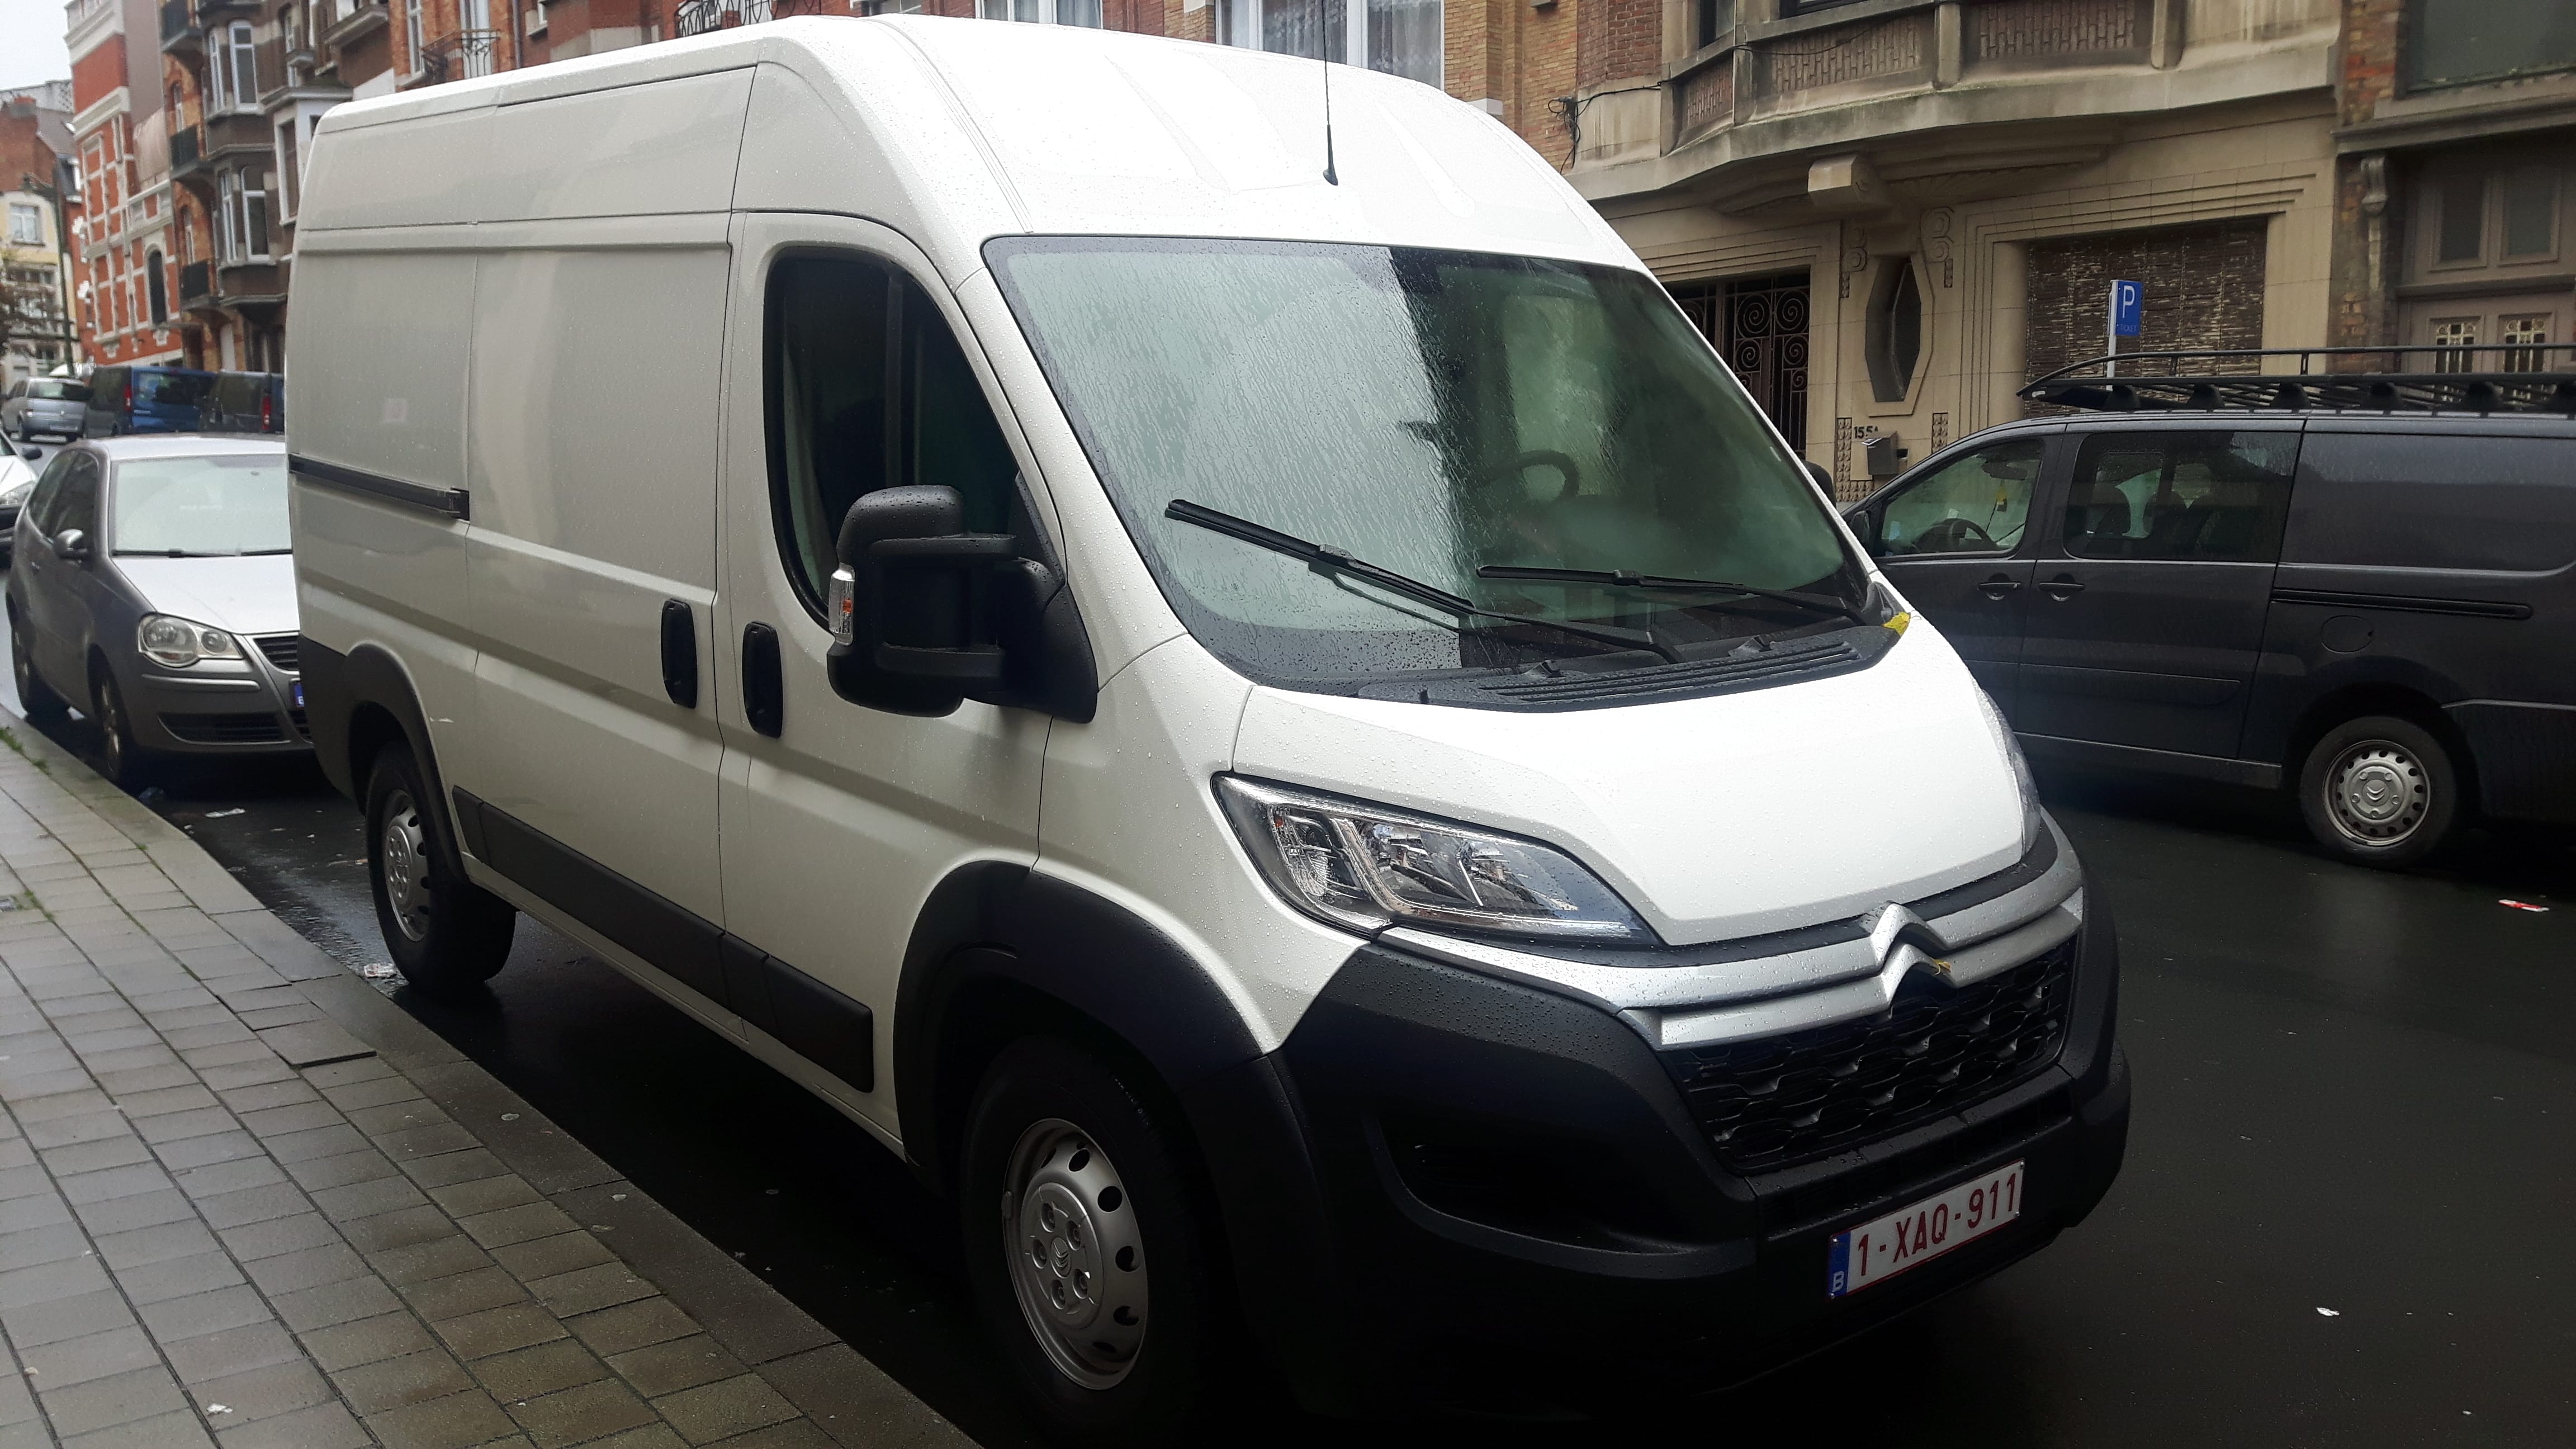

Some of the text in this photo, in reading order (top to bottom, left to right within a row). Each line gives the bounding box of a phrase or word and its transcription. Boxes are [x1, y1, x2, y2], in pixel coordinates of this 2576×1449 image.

[2122, 285, 2135, 318] P
[1858, 1173, 2016, 1276] 1-XAQ-911
[1832, 1271, 1844, 1292] B
